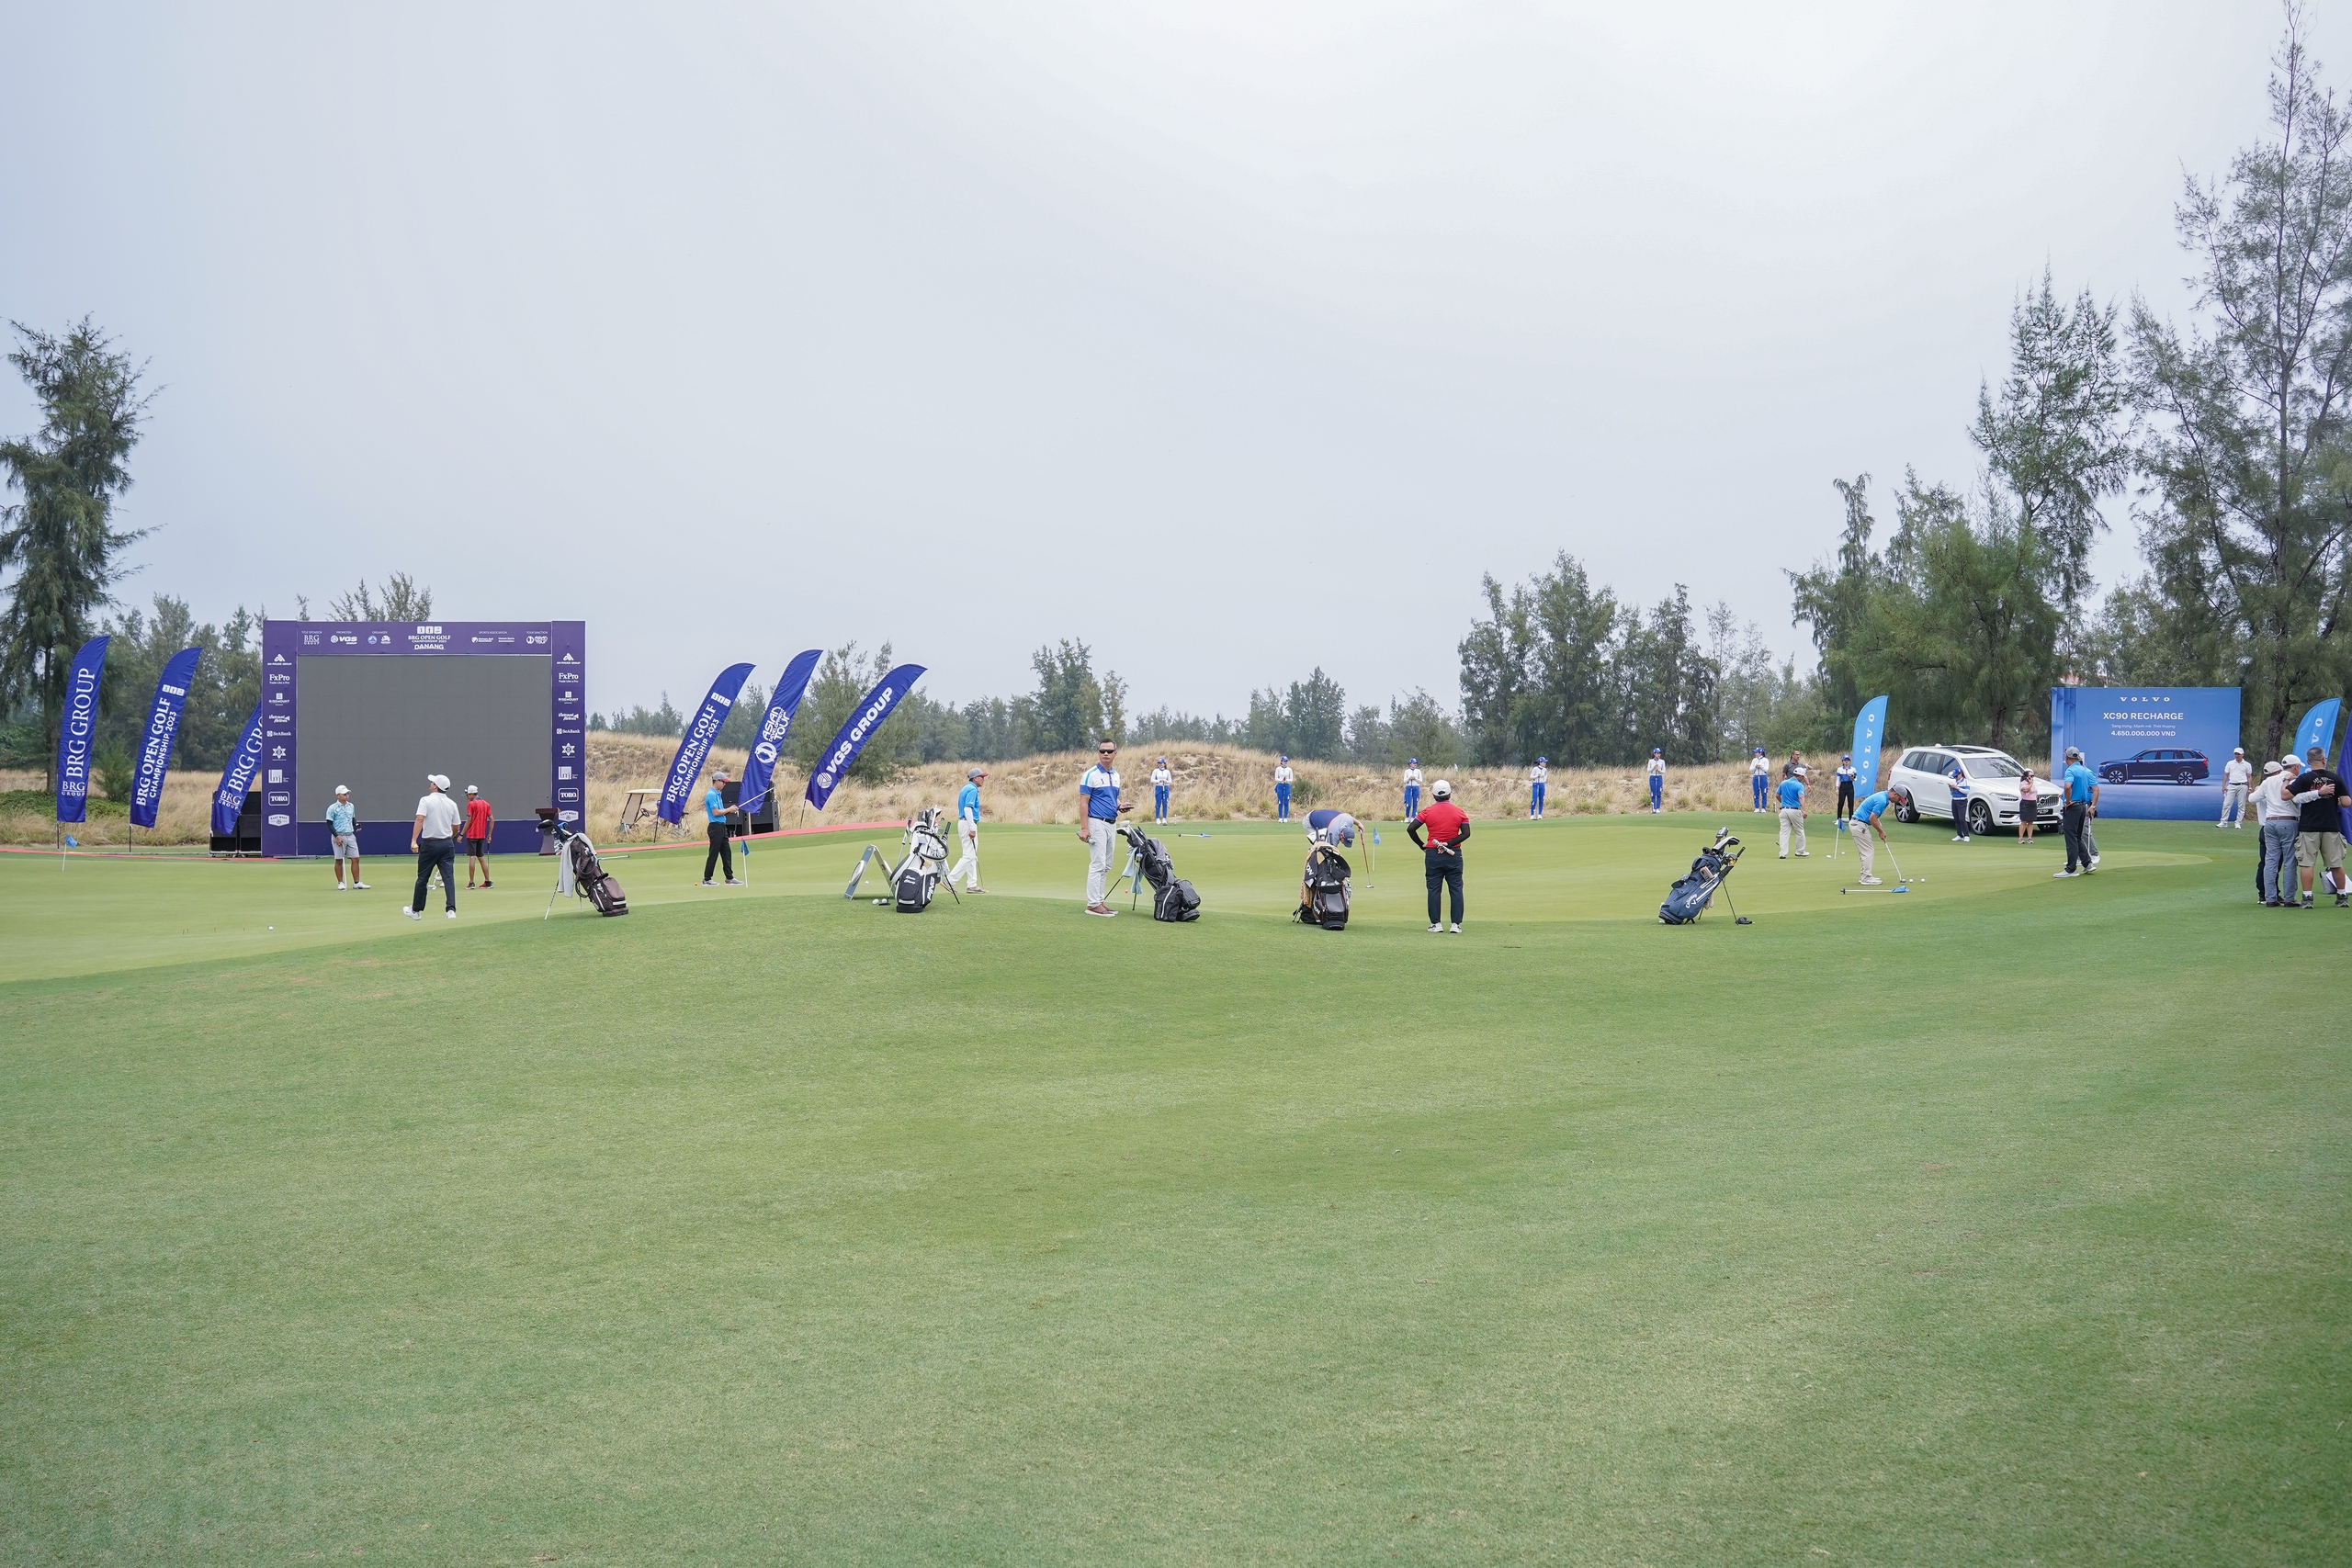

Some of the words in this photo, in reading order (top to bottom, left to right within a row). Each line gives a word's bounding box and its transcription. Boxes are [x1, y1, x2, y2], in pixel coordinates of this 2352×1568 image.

[70, 668, 95, 736] GROUP
[152, 697, 170, 735] GOLF
[763, 707, 781, 740] ASIAN
[774, 712, 790, 740] TOUR
[826, 741, 852, 773] VGS
[850, 687, 893, 742] GROUP
[66, 740, 86, 778] BRG
[142, 736, 160, 775] OPEN
[149, 733, 170, 798] CHAMPIONSHIP
[166, 711, 176, 732] 2023
[666, 775, 683, 803] BRG
[677, 739, 700, 774] OPEN
[694, 704, 716, 738] GOLF
[679, 738, 708, 797] CHAMPIONSHIP
[706, 719, 719, 738] 2023
[1861, 714, 1875, 785] VOLVO
[62, 781, 85, 790] BRG
[136, 777, 151, 806] BRG
[228, 754, 255, 792] BRG
[218, 799, 239, 810] GROUP
[220, 790, 242, 805] BRG
